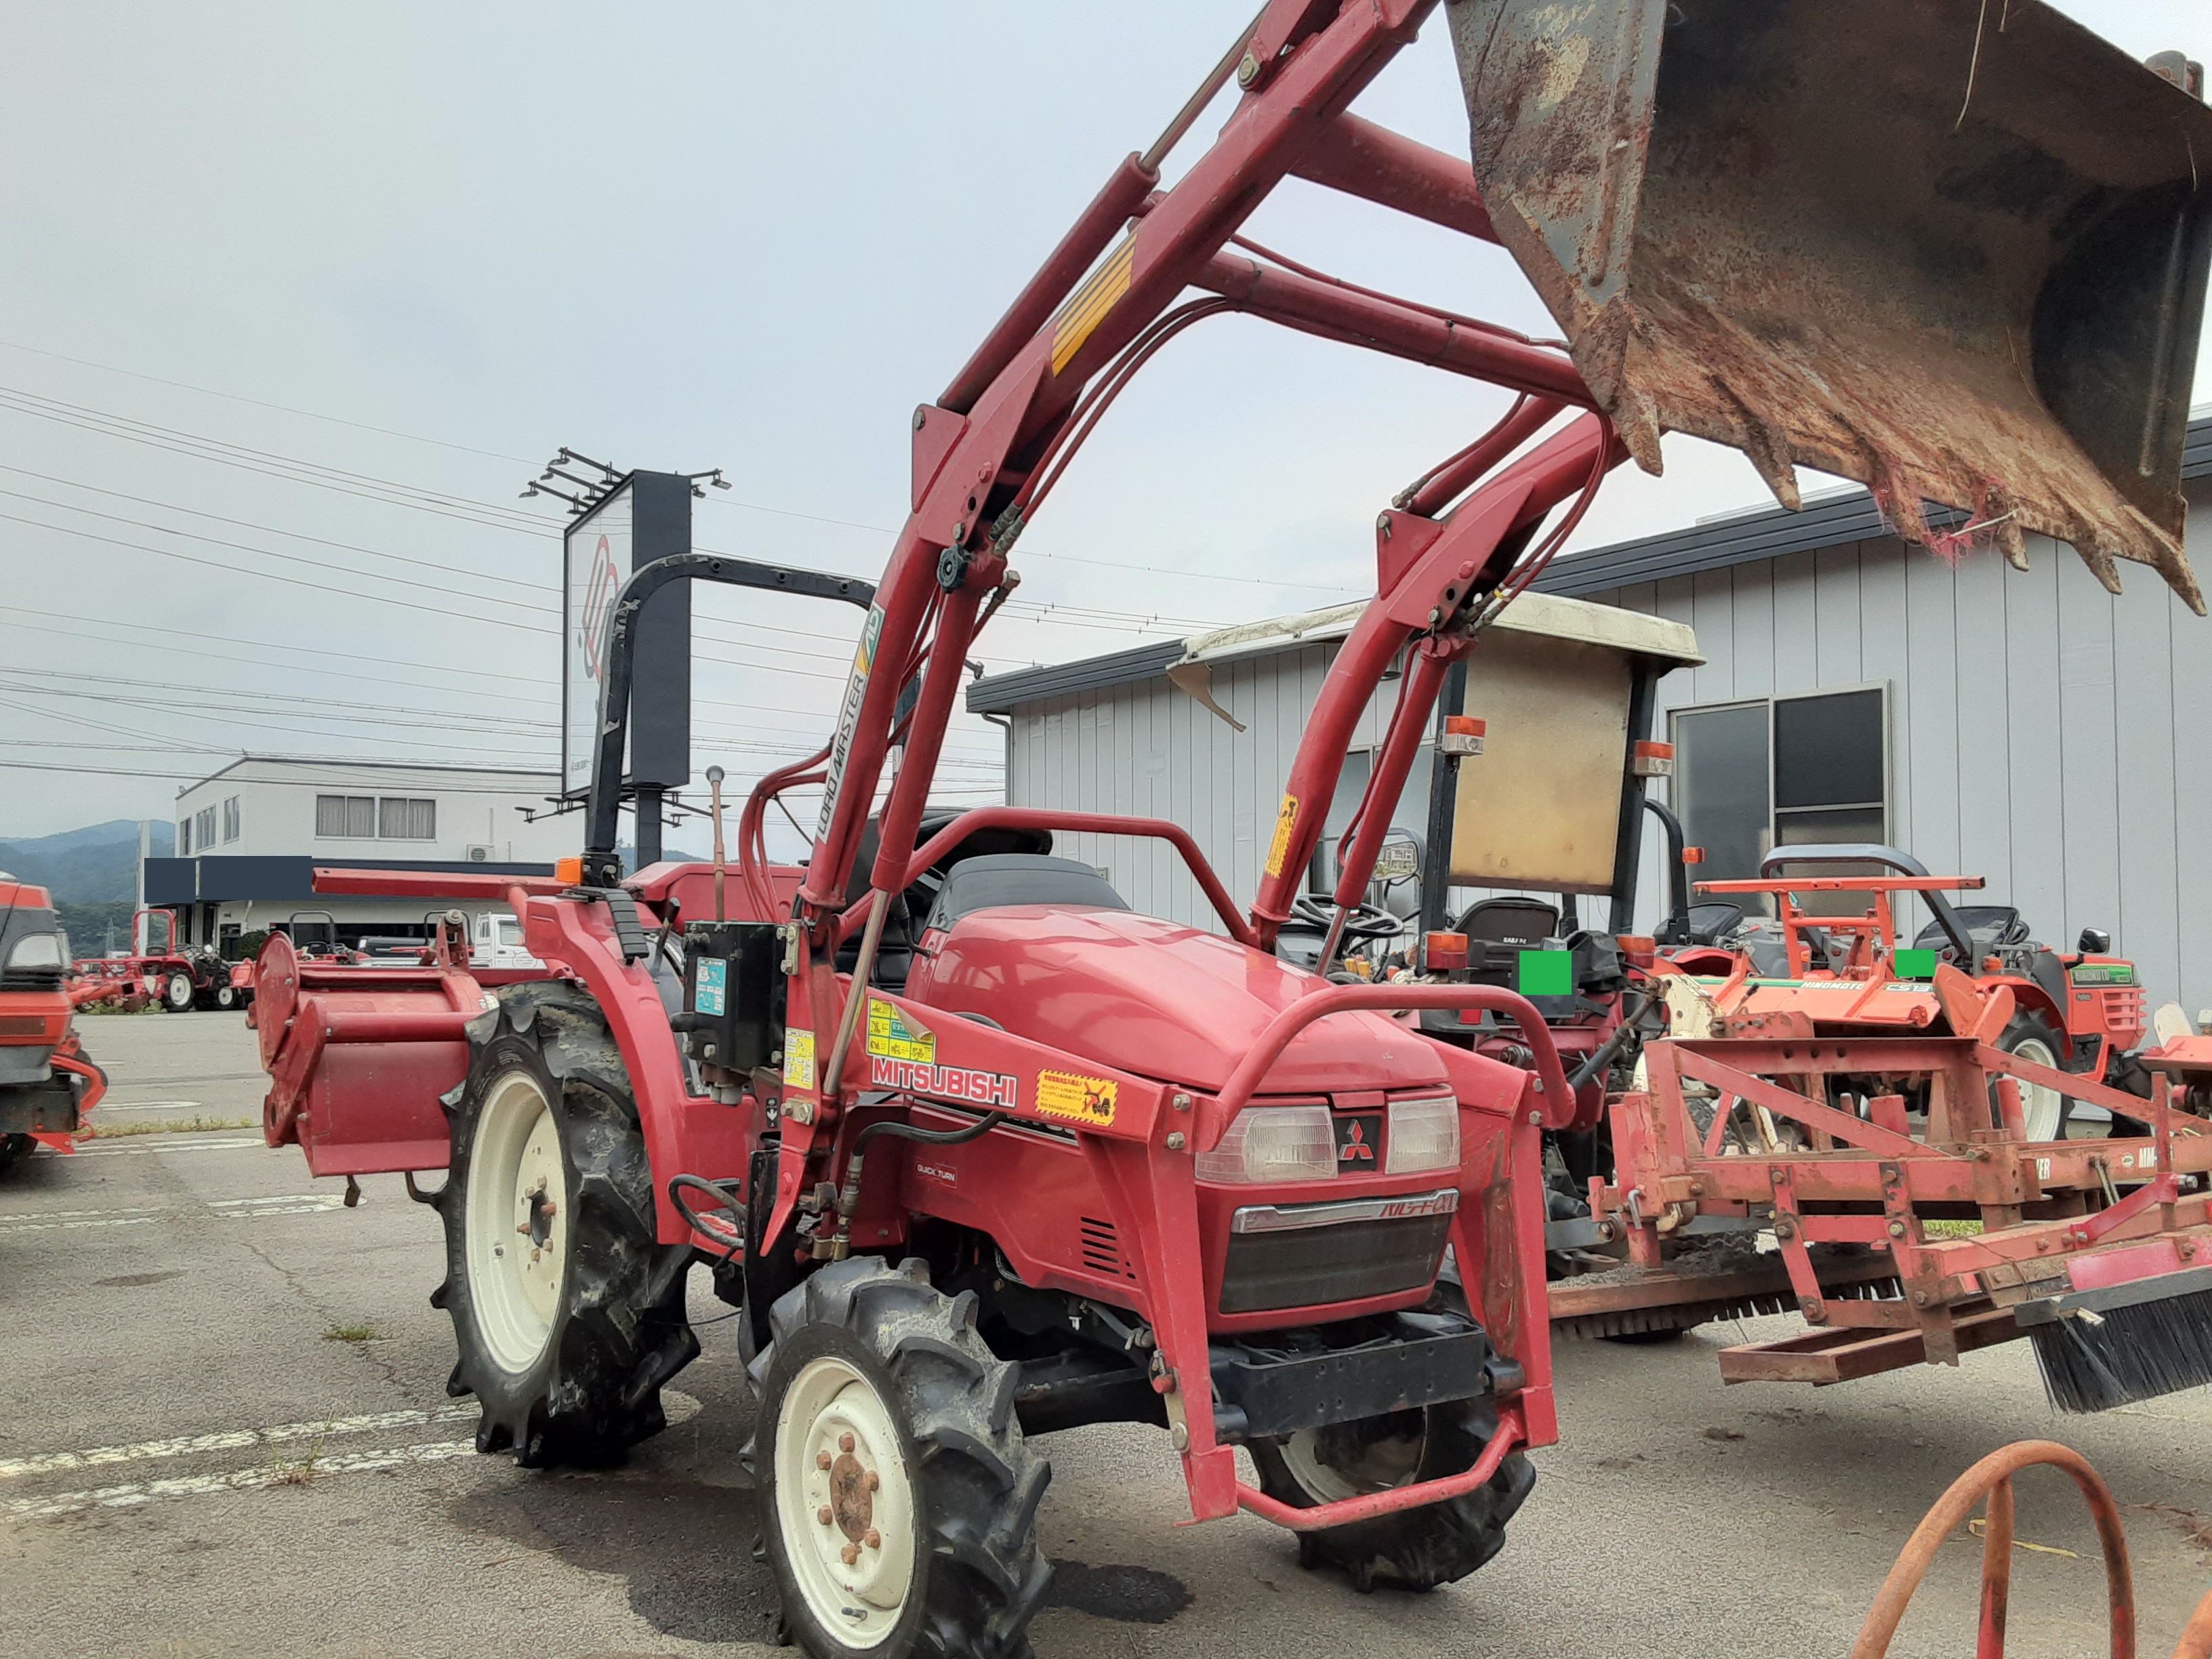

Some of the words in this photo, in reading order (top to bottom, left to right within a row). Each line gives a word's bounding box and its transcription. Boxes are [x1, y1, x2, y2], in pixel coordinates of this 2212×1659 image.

[833, 676, 864, 778] MASTER
[873, 1058, 1017, 1107] MITSUBISHI
[918, 1164, 936, 1176] QUICK
[938, 1170, 955, 1181] TURN
